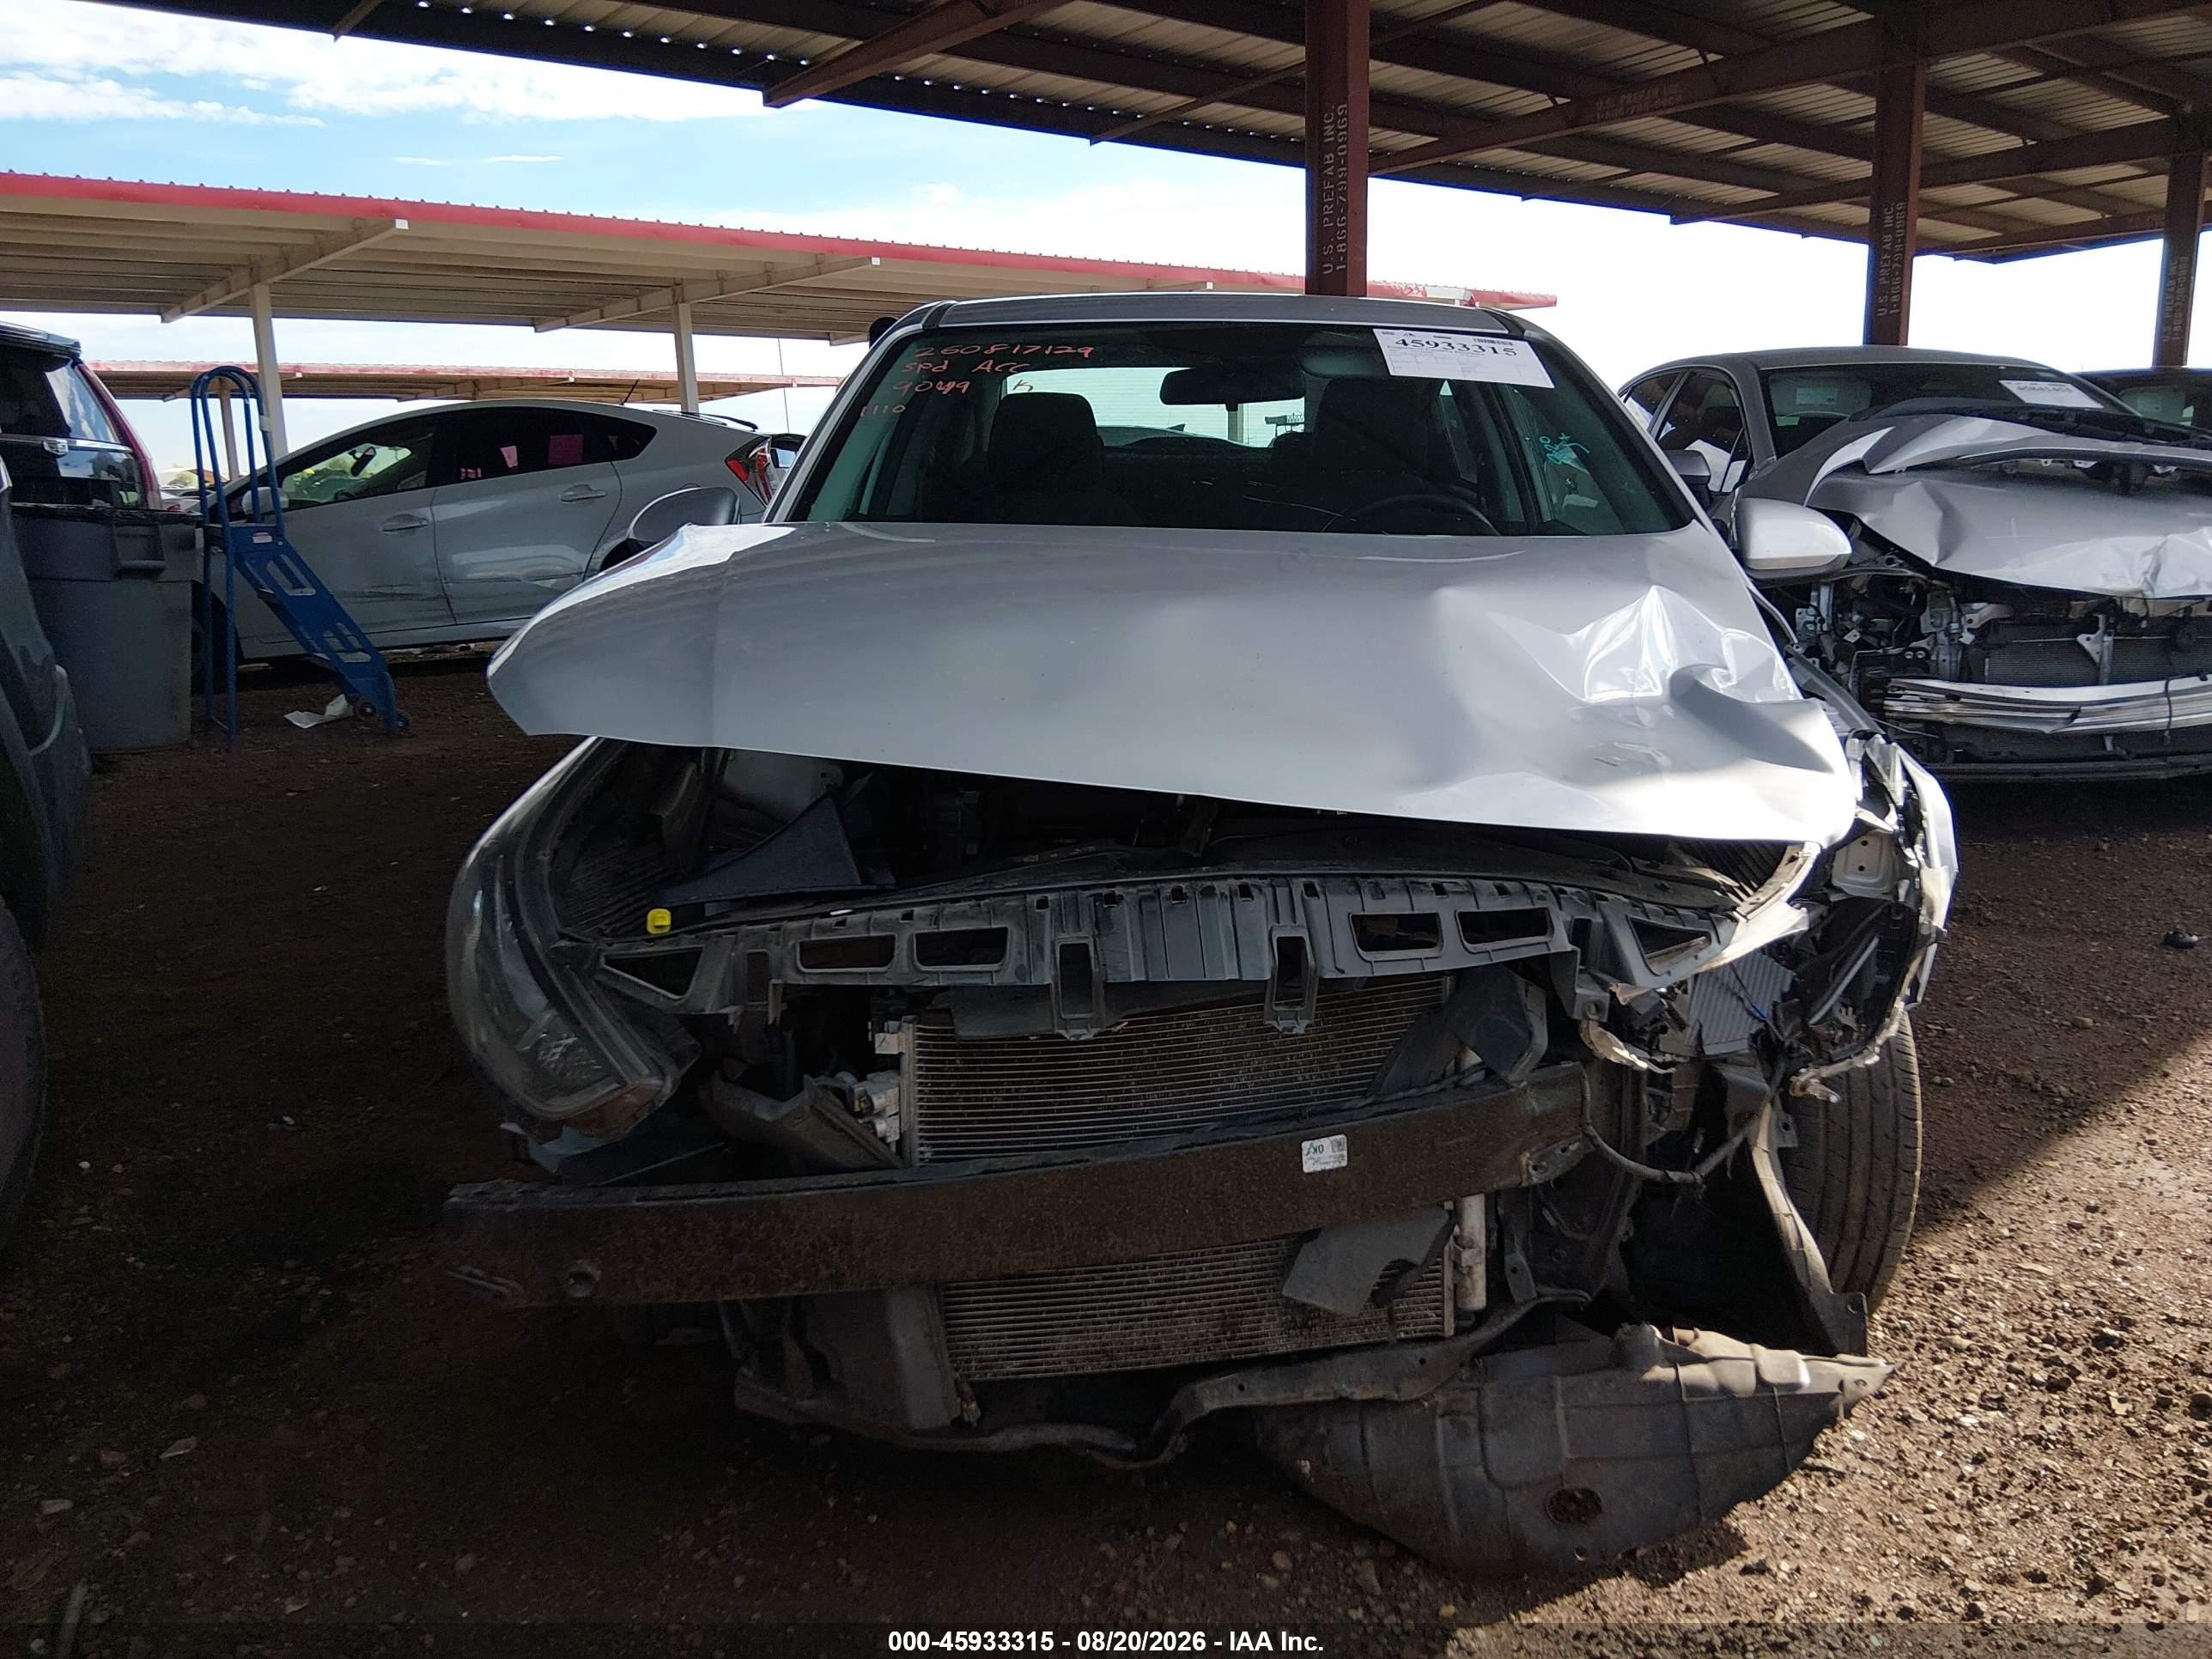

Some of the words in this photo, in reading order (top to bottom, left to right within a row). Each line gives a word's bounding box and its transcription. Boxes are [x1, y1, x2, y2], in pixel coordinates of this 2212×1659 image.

[1323, 105, 1335, 143] INC.
[1323, 153, 1334, 227] PREFAB
[1336, 104, 1347, 271] 1-866-799-0969
[1322, 238, 1334, 275] U.S.
[915, 344, 1096, 358] 260817129
[1395, 337, 1518, 357] 45933315
